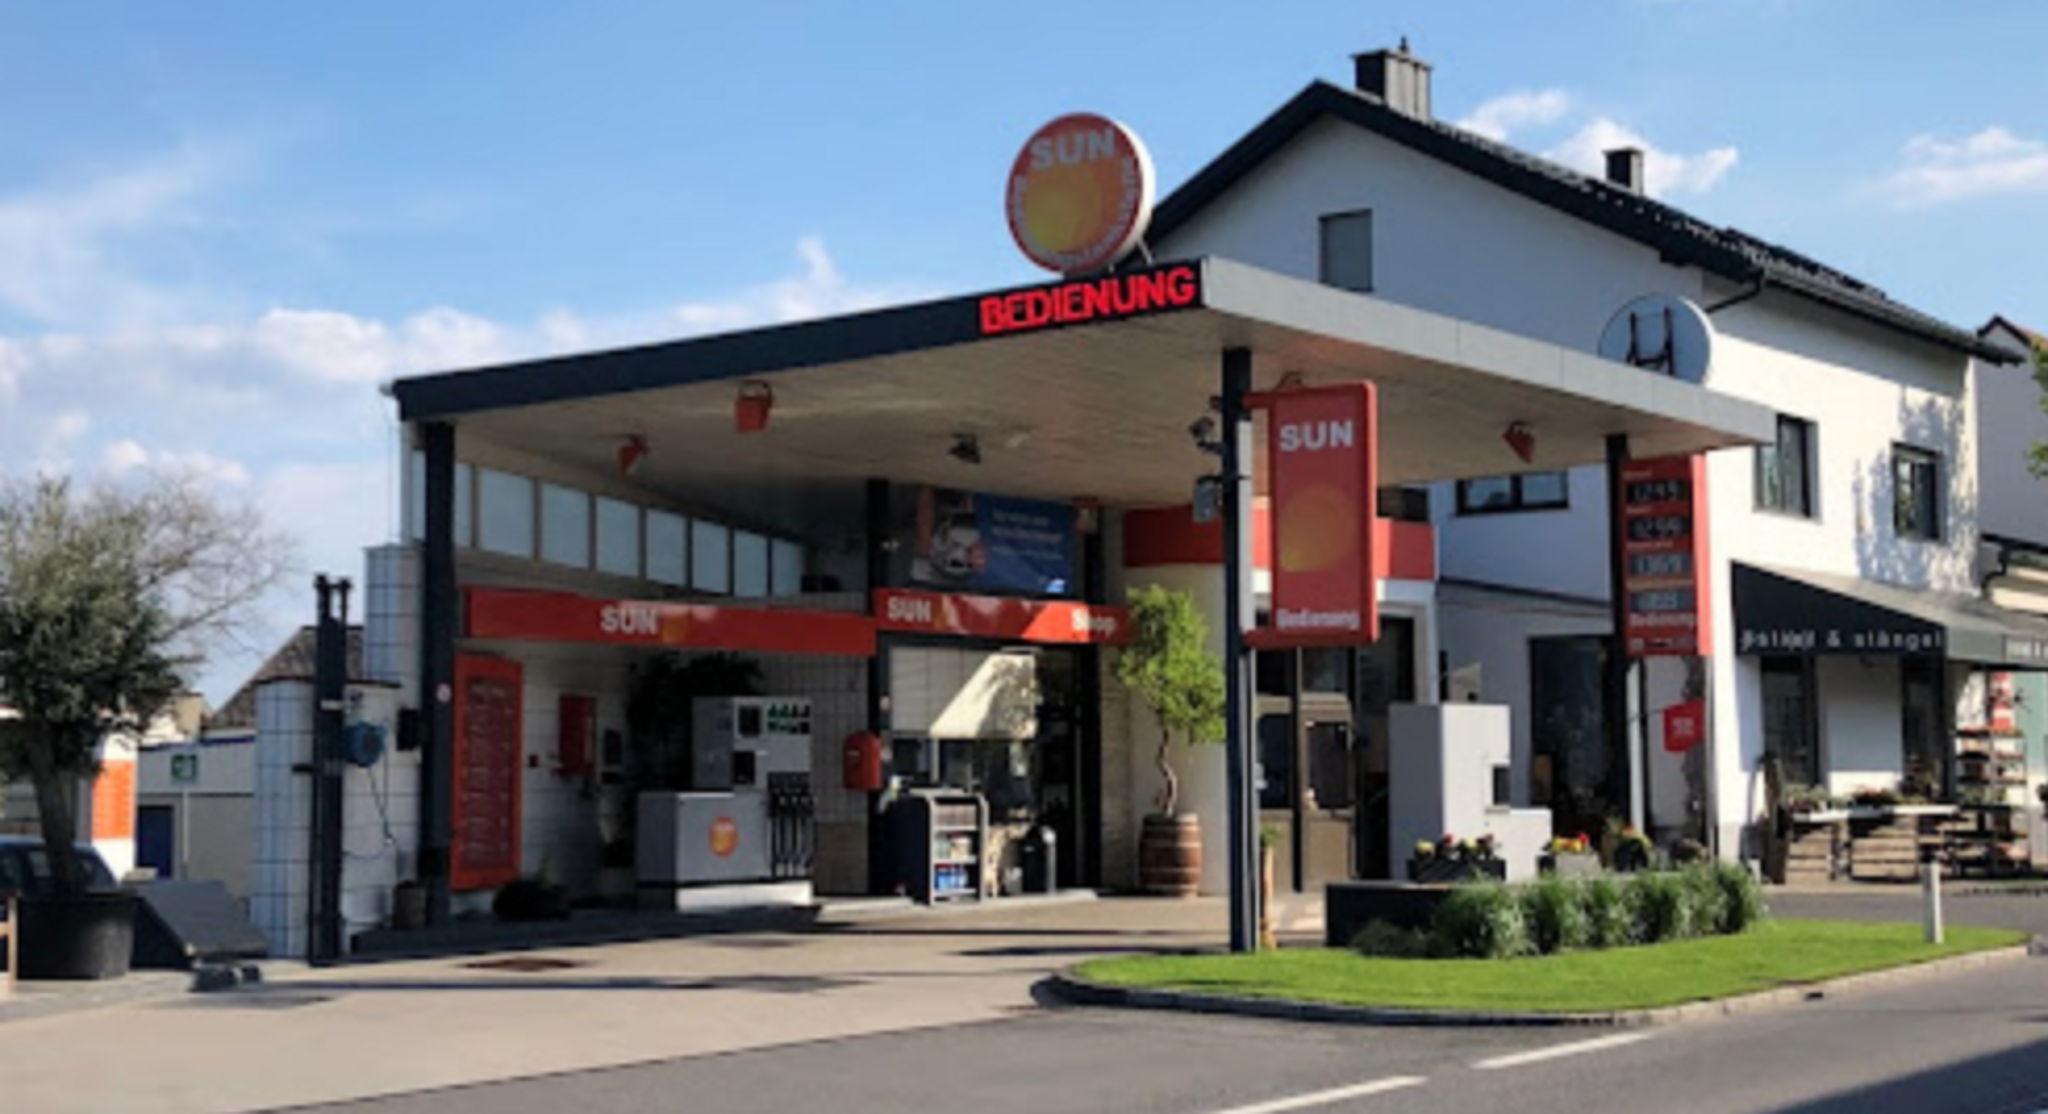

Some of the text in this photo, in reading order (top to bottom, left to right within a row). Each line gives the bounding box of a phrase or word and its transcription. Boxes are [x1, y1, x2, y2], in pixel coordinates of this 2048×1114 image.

[1030, 127, 1116, 171] SUN
[980, 265, 1196, 335] BEDIENUNG
[1279, 420, 1354, 452] SUN
[600, 604, 659, 635] SUN
[887, 595, 933, 624] SUN
[1070, 607, 1117, 638] Shop
[1275, 608, 1361, 631] Bedienung
[1826, 628, 1842, 649] &
